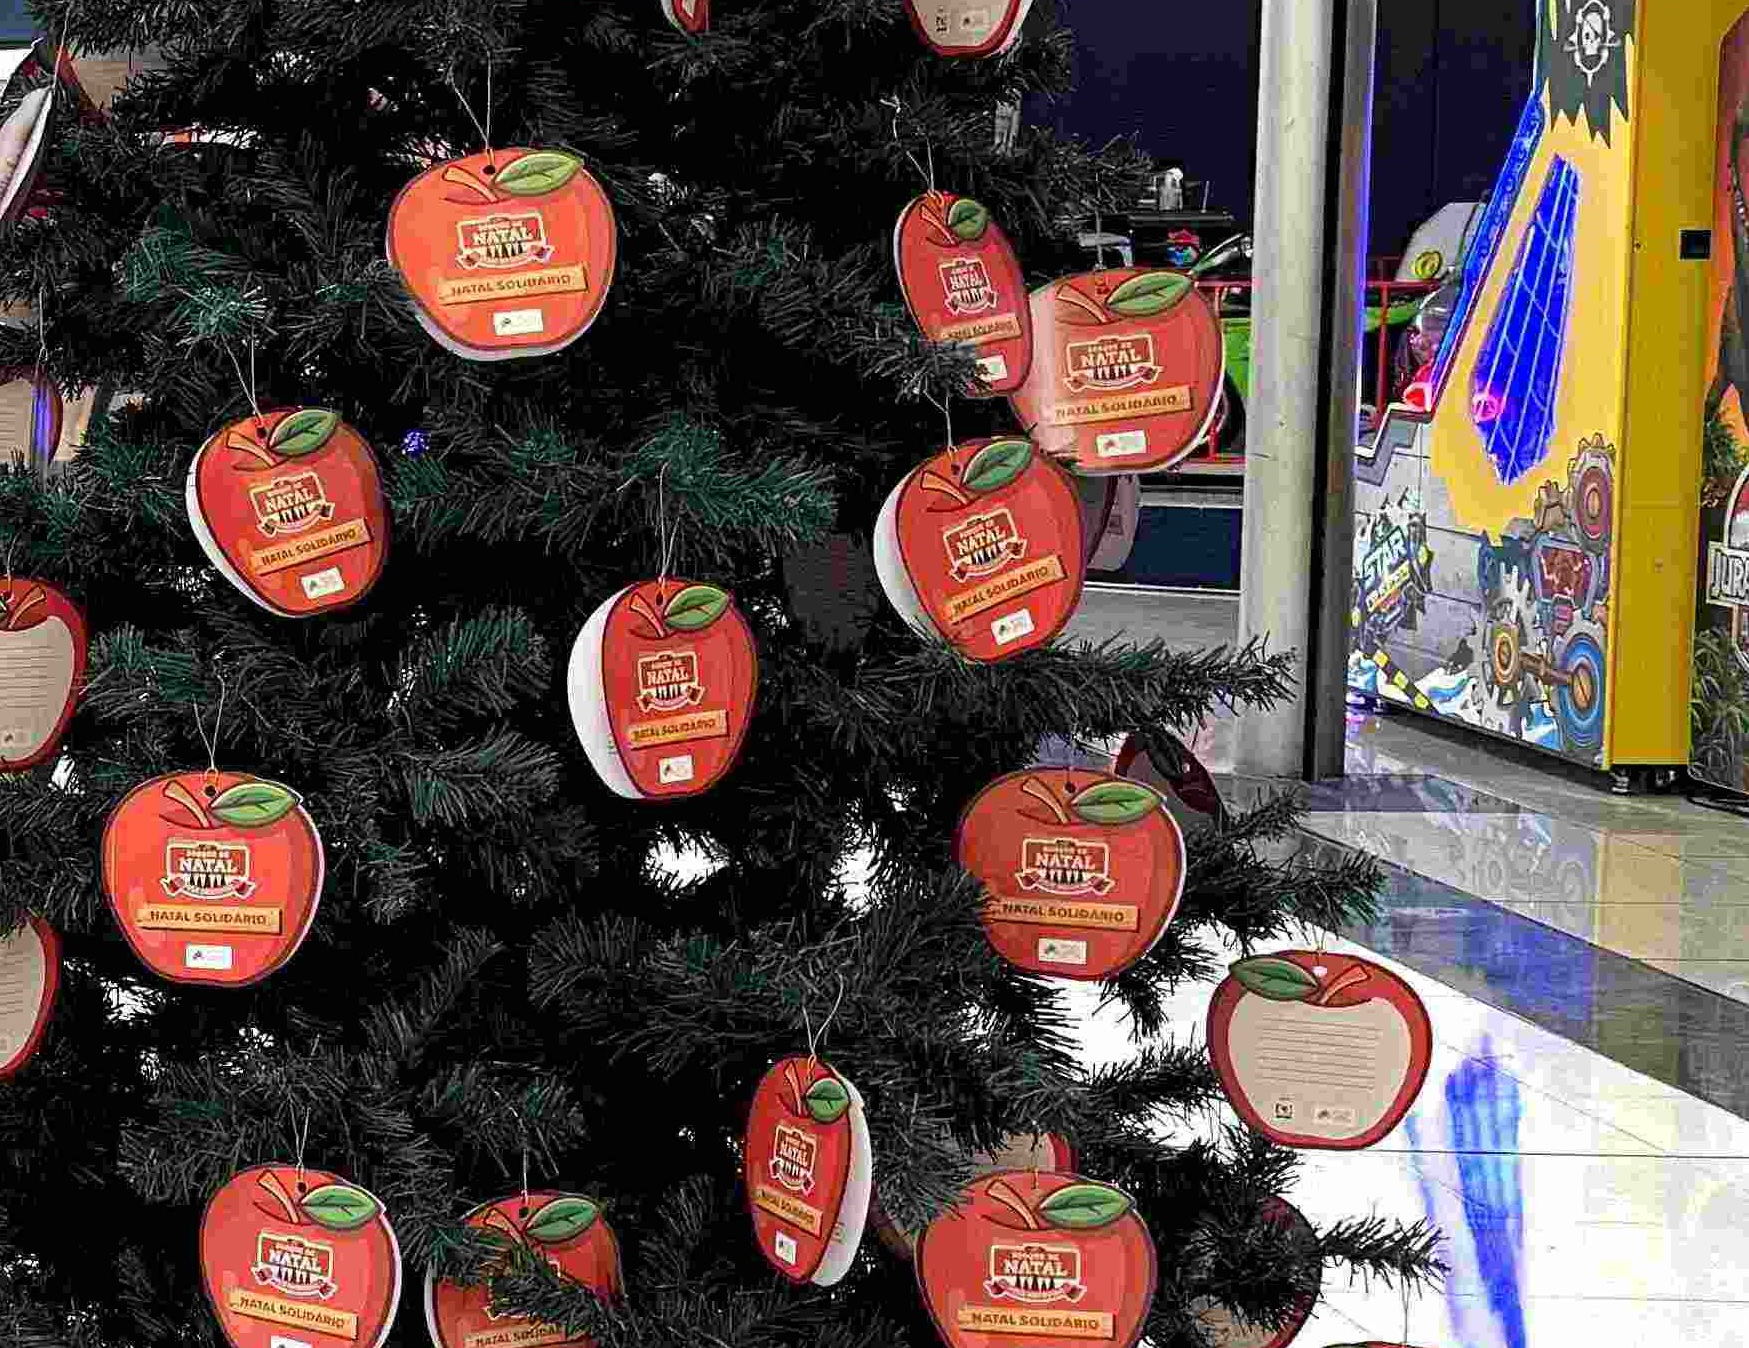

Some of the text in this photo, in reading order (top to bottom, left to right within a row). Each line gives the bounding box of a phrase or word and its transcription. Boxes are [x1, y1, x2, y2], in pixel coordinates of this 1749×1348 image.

[471, 227, 534, 248] NATAL
[1079, 348, 1142, 368] NATAL
[266, 489, 315, 512] NATAL
[956, 525, 1007, 553] NATAL
[647, 667, 690, 688] NATAL
[178, 856, 242, 874] NATAL
[1035, 852, 1096, 870] NATAL
[269, 1250, 324, 1273] NATAL
[1003, 1259, 1067, 1277] NATAL
